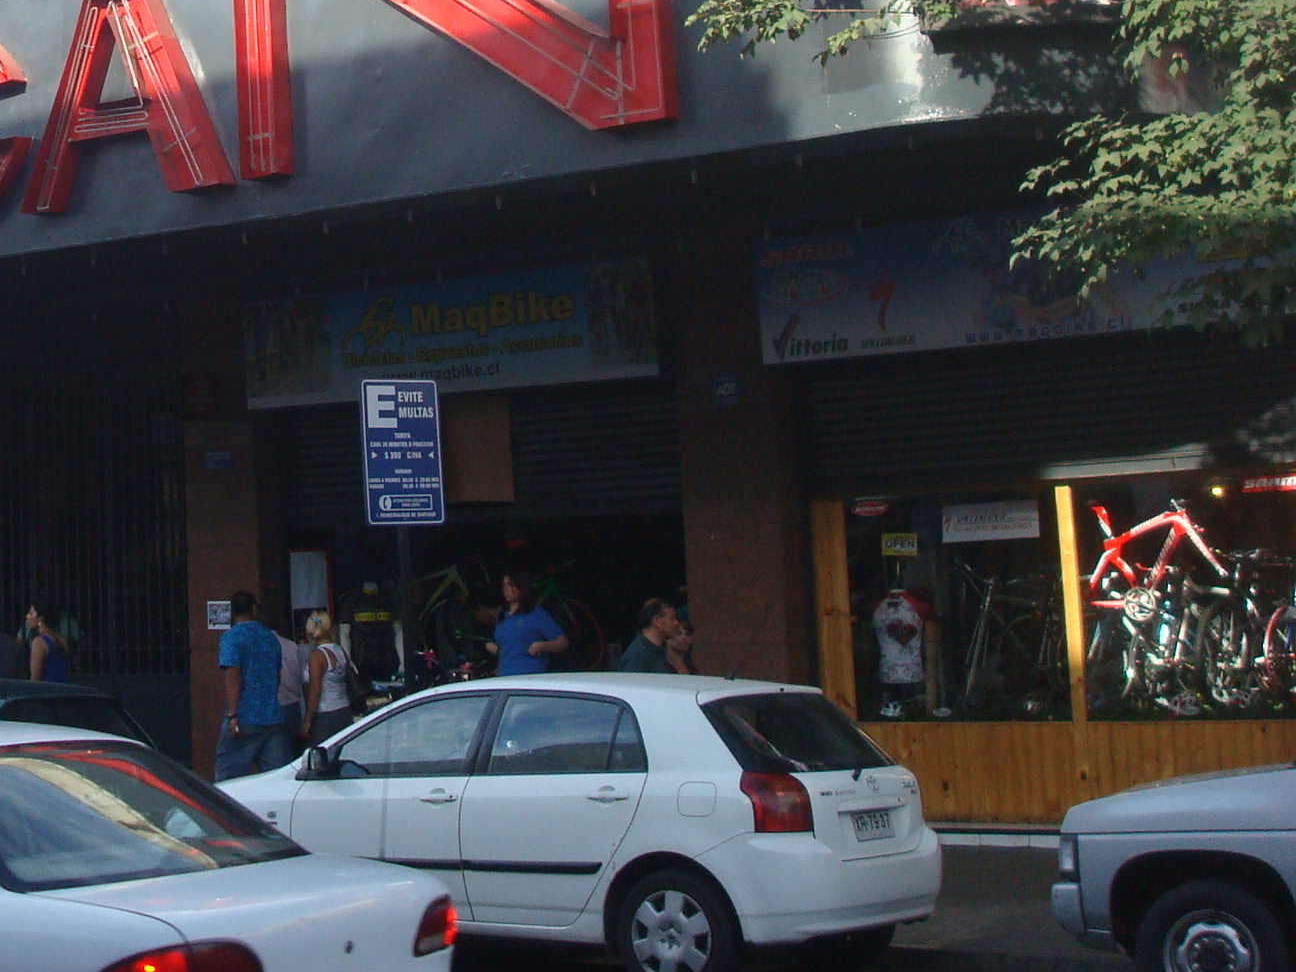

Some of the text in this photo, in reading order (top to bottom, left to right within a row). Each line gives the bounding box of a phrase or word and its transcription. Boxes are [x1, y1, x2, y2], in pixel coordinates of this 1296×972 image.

[410, 290, 577, 336] MaqBike
[772, 312, 849, 361] Vittoria
[417, 344, 490, 364] Repuestos
[367, 385, 397, 428] E
[398, 391, 424, 403] EVITE
[399, 407, 434, 418] MULTAS
[885, 539, 915, 548] OPEN
